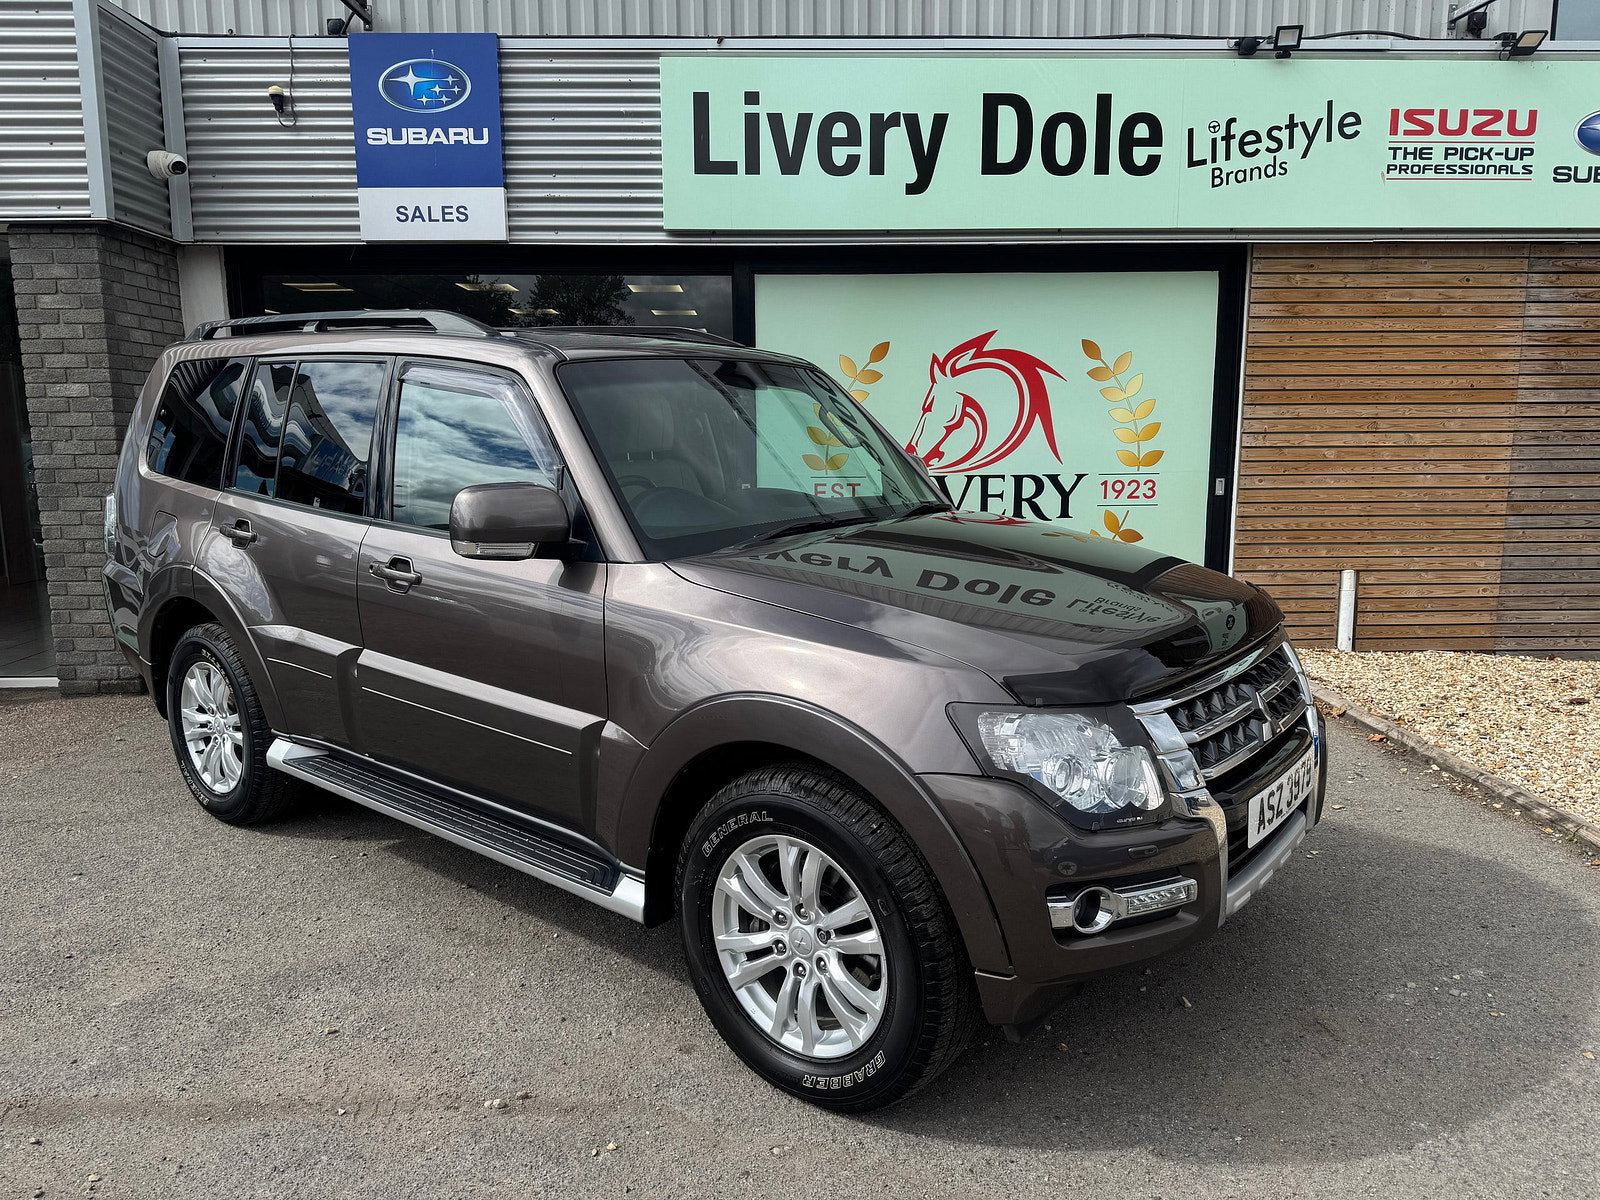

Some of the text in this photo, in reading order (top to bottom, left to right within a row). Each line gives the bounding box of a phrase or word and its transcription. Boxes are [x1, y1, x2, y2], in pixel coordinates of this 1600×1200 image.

[366, 127, 489, 145] SUBARU
[1187, 99, 1362, 168] Lifestyle
[1388, 109, 1538, 137] ISUZU
[692, 91, 1164, 195] Livery Dole
[1388, 146, 1535, 162] THE PICK-UP
[1210, 156, 1289, 188] Brands
[1386, 164, 1534, 176] PROFESSIONALS
[395, 205, 470, 223] SALES
[929, 473, 1088, 522] VERY
[1100, 478, 1157, 500] 1923
[1256, 782, 1284, 835] ASZ
[701, 810, 774, 858] GENERAL
[801, 1050, 887, 1091] GRABBER
